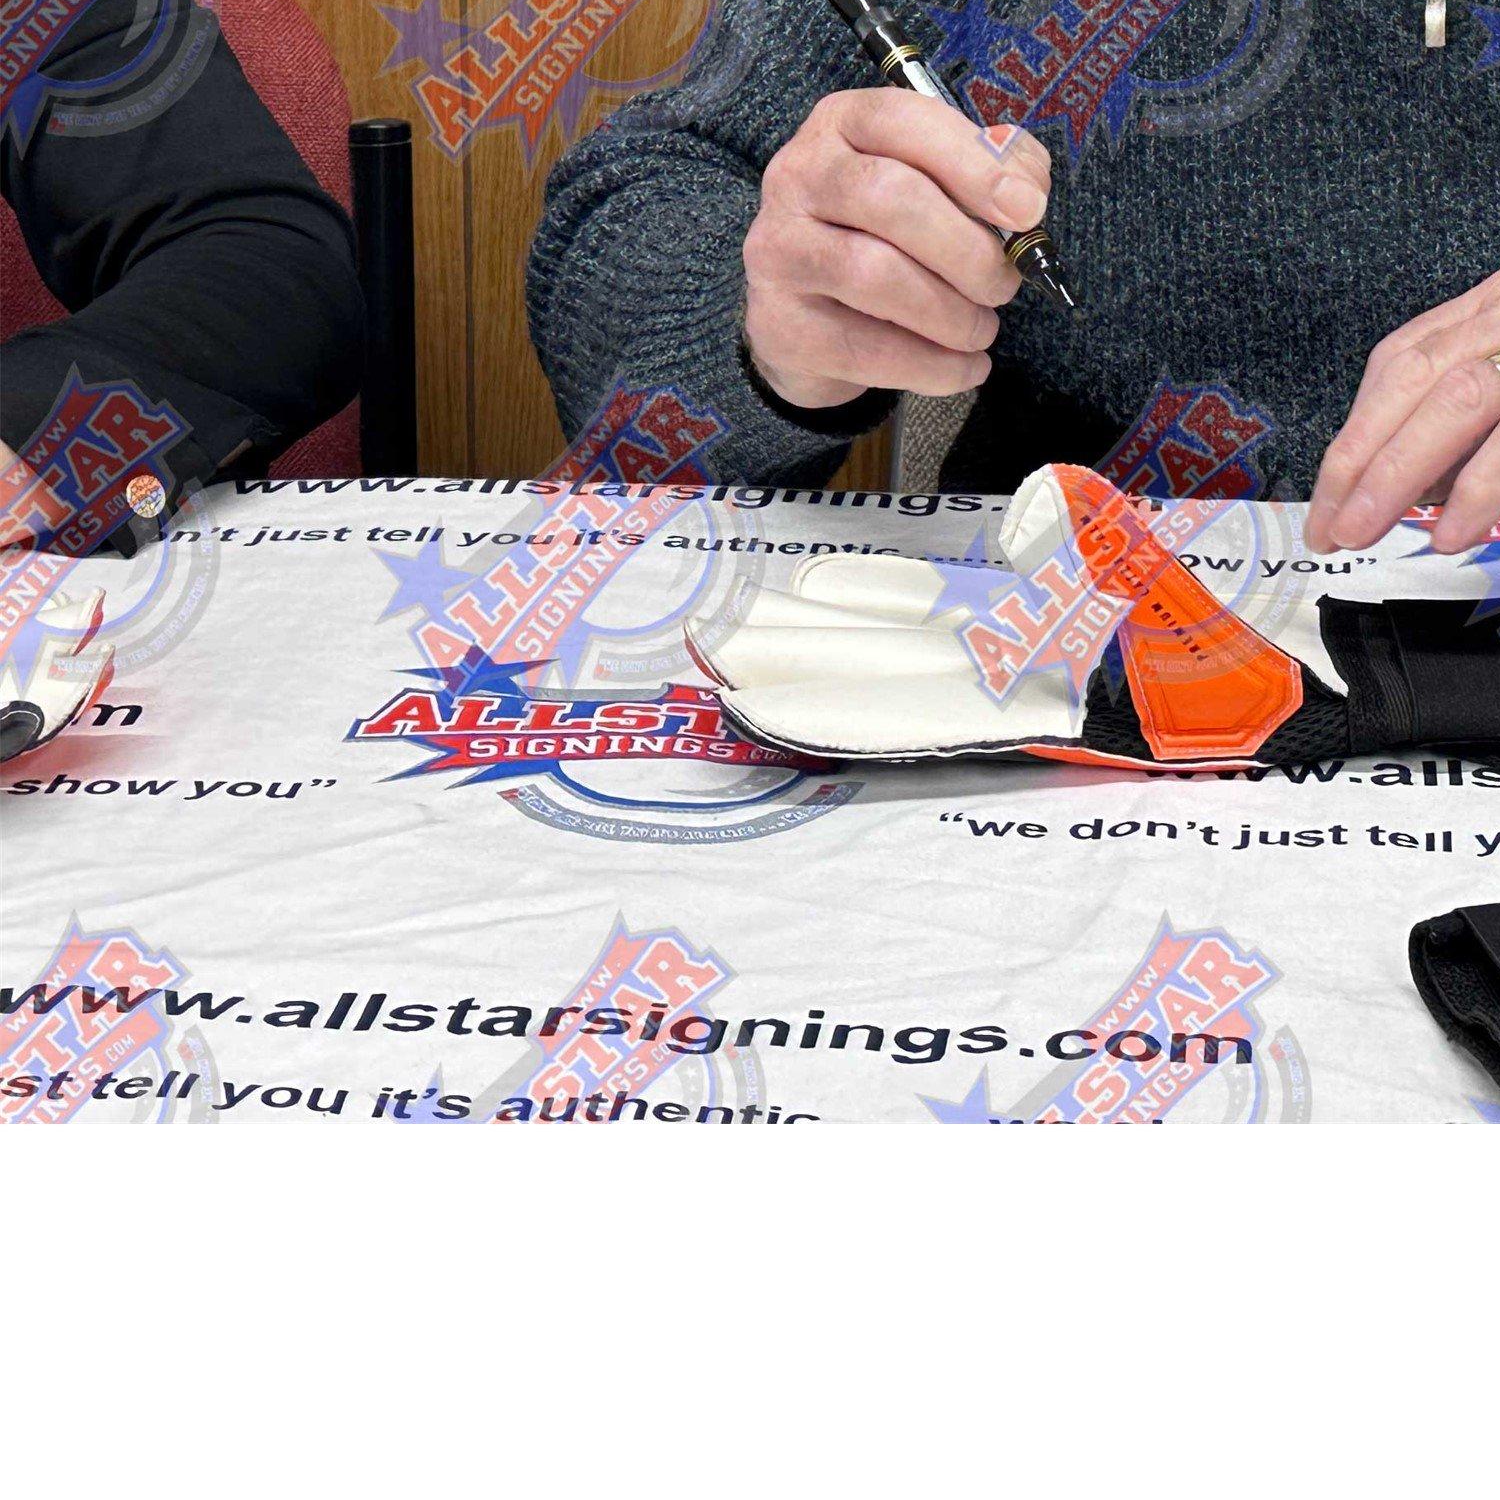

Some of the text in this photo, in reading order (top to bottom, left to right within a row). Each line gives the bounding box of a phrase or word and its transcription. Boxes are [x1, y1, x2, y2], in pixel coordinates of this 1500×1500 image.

[244, 526, 355, 547] just
[365, 526, 445, 543] tell
[456, 529, 553, 548] you
[572, 528, 645, 547] it's
[468, 733, 737, 759] SIGNINGS
[7, 774, 178, 795] show
[1069, 818, 1219, 847] don't
[1232, 824, 1349, 850] just
[1365, 825, 1453, 852] tell
[0, 983, 1253, 1064] www.allstarsignings.com
[91, 1070, 200, 1100] tell
[212, 1082, 350, 1116] you
[370, 1086, 473, 1119] it's
